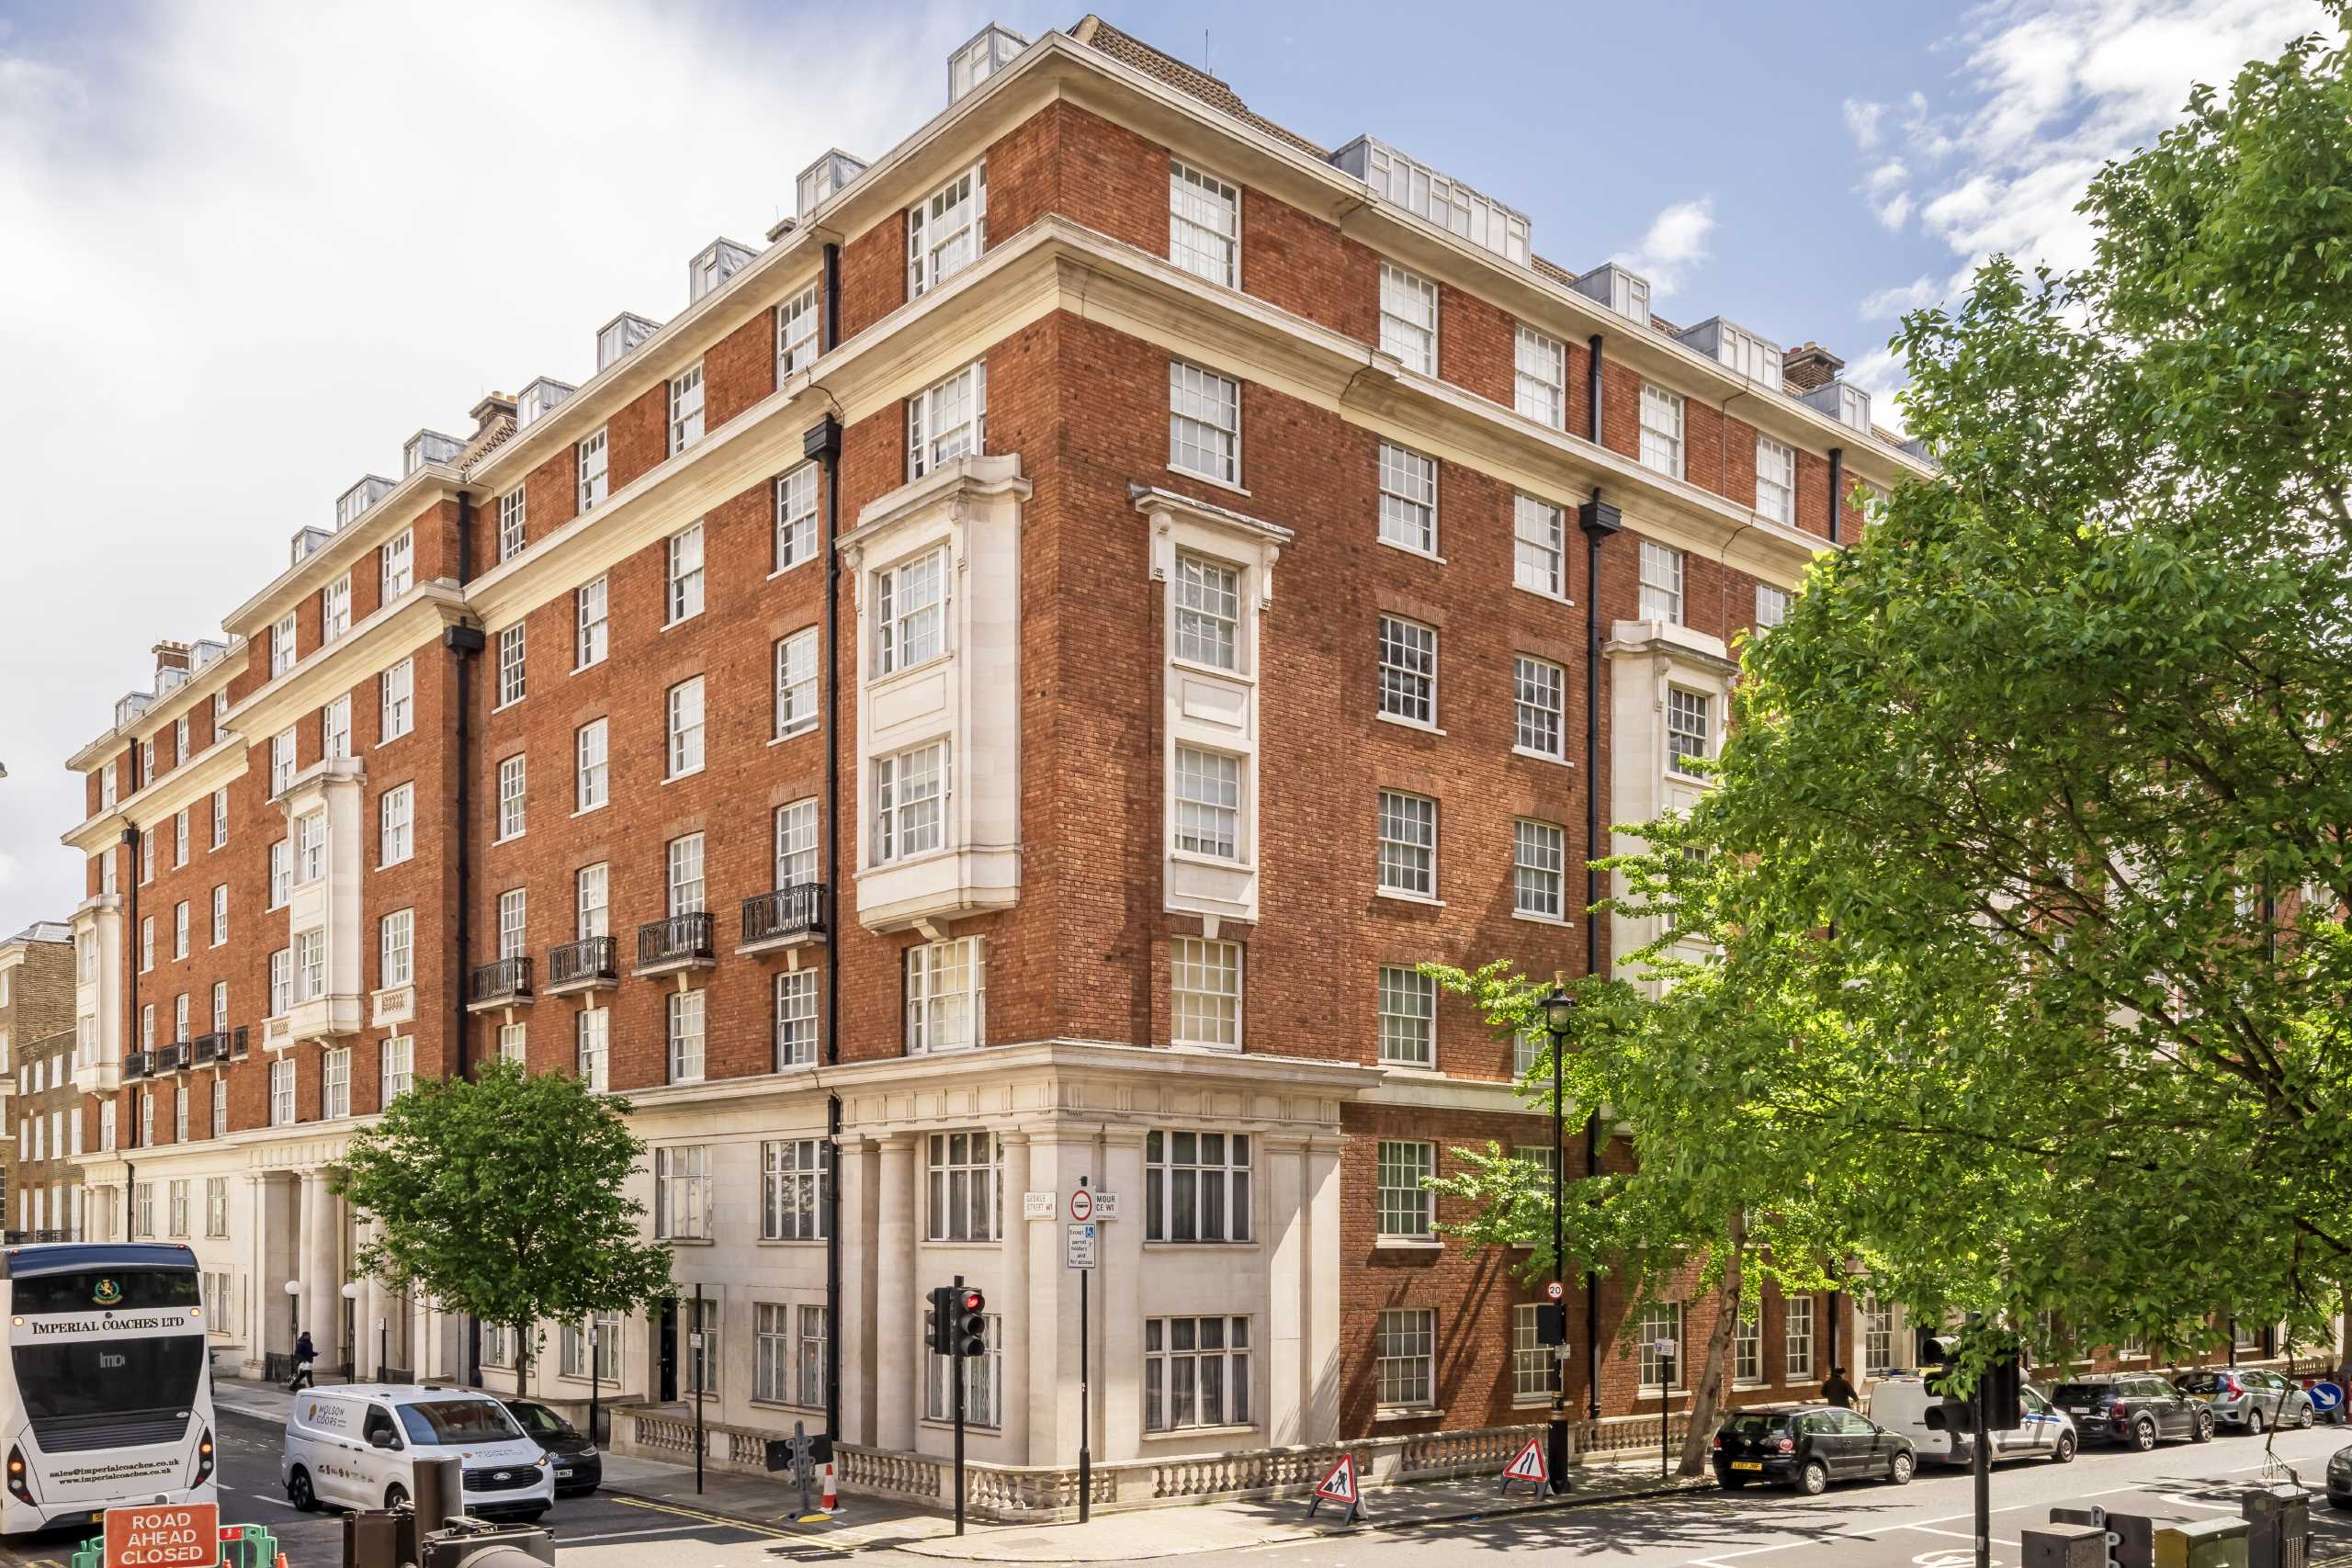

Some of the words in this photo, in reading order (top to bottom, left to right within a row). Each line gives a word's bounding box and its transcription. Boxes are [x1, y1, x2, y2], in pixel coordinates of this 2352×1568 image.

[32, 1321, 99, 1335] IMPERIAL
[102, 1317, 158, 1330] COACHES
[162, 1316, 185, 1327] LTD
[319, 1404, 345, 1416] MOLSON
[316, 1415, 337, 1427] COORS
[50, 1459, 180, 1478] sales@imperialcoaches.co.uk
[59, 1468, 172, 1485] www.imperialcoaches.co.uk
[132, 1512, 191, 1529] ROAD
[128, 1529, 197, 1548] AHEAD
[120, 1546, 203, 1565] CLOSED
